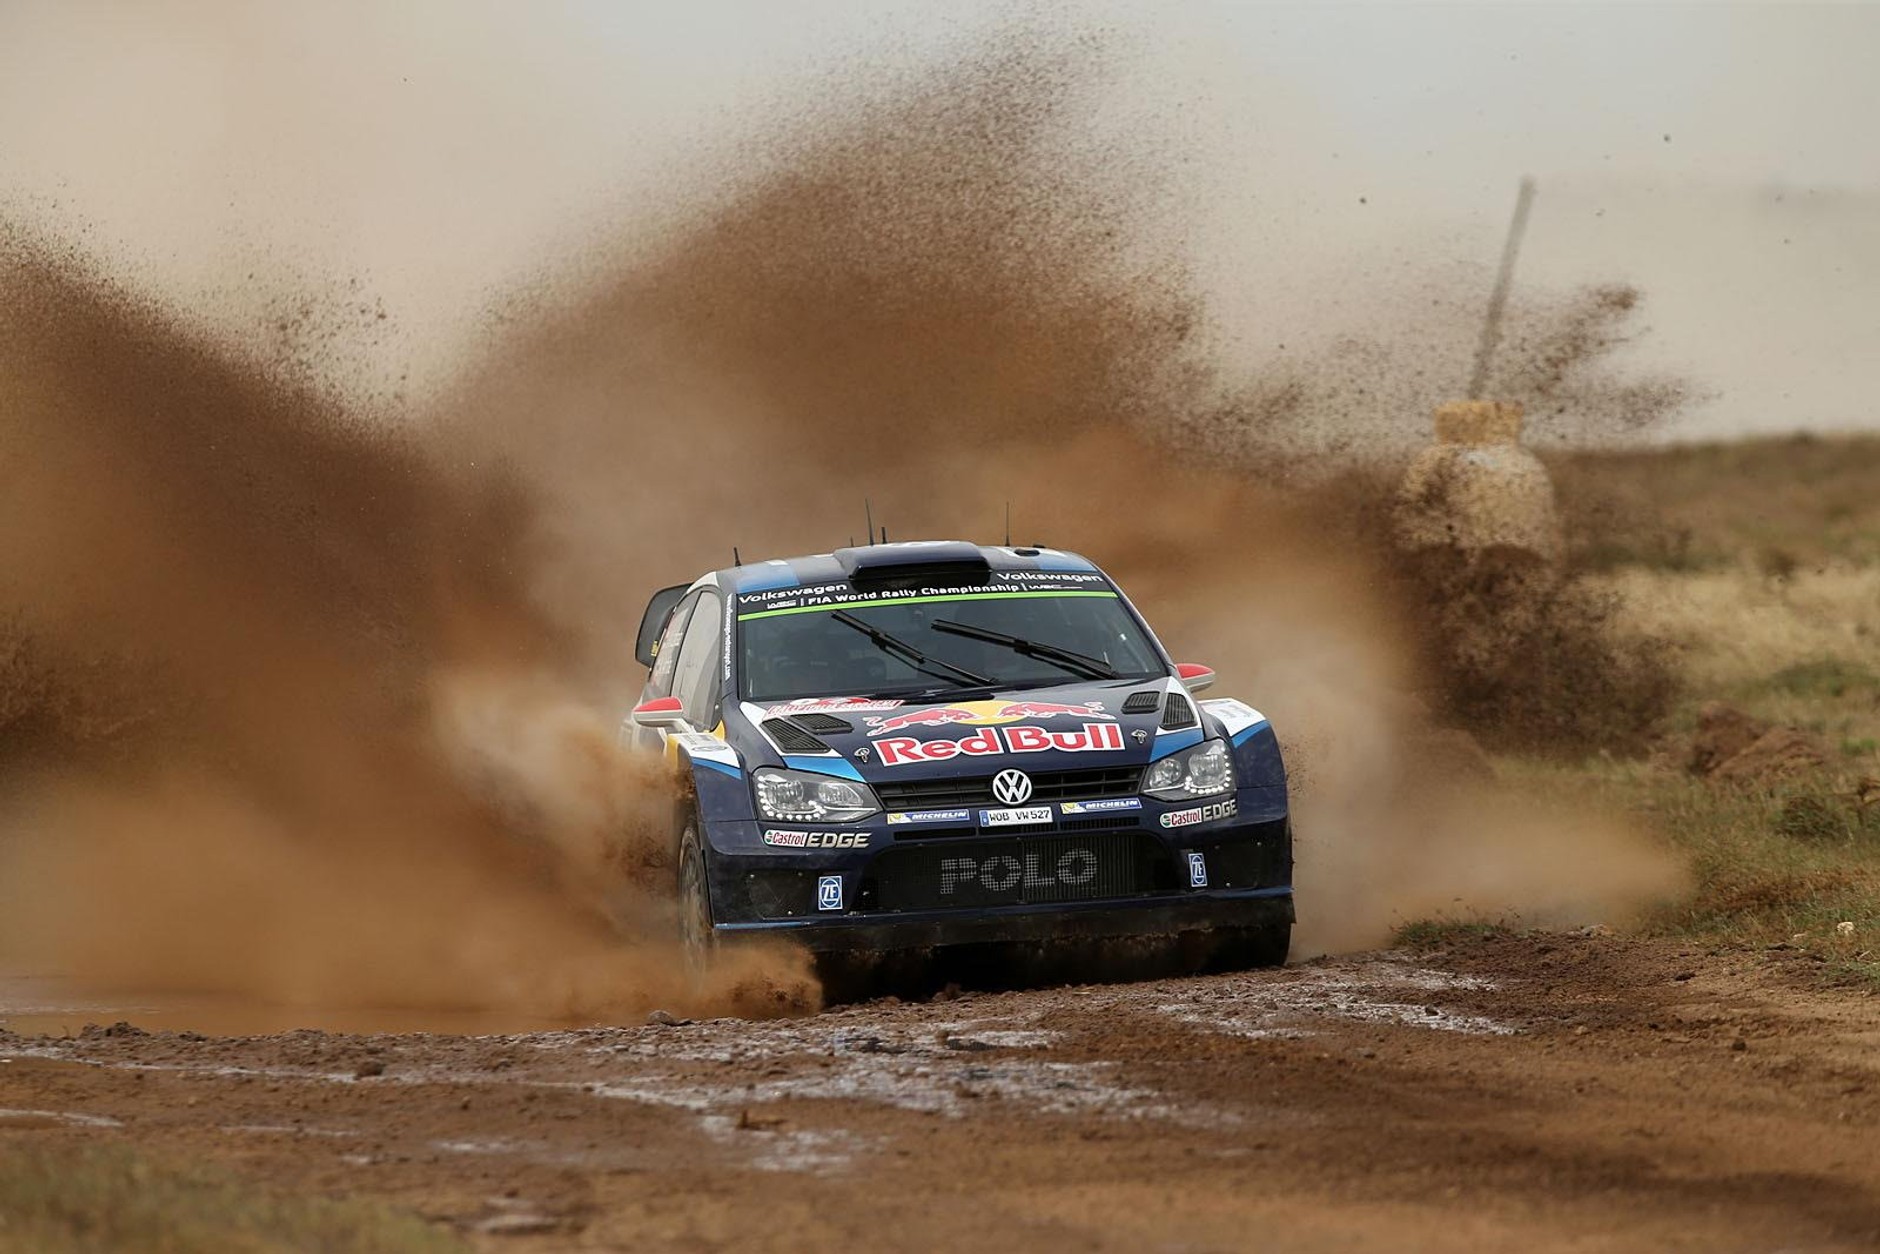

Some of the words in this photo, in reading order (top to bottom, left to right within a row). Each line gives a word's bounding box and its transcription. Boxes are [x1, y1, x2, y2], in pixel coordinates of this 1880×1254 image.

[997, 572, 1103, 583] Volkswagen
[738, 584, 848, 604] Volkswagen
[808, 596, 832, 605] FIA
[835, 592, 877, 602] World
[881, 589, 917, 598] Rally
[921, 583, 1020, 595] Championship
[875, 727, 1001, 764] Red
[1006, 724, 1123, 751] Bull
[1086, 798, 1138, 809] MICHELIN
[1171, 809, 1202, 826] Castrol
[1203, 799, 1238, 820] EDGE
[912, 811, 967, 821] MICHELIN
[989, 811, 1010, 822] WOB
[773, 832, 805, 846] Castrol
[806, 832, 872, 848] EDGE
[940, 849, 1098, 895] POLO
